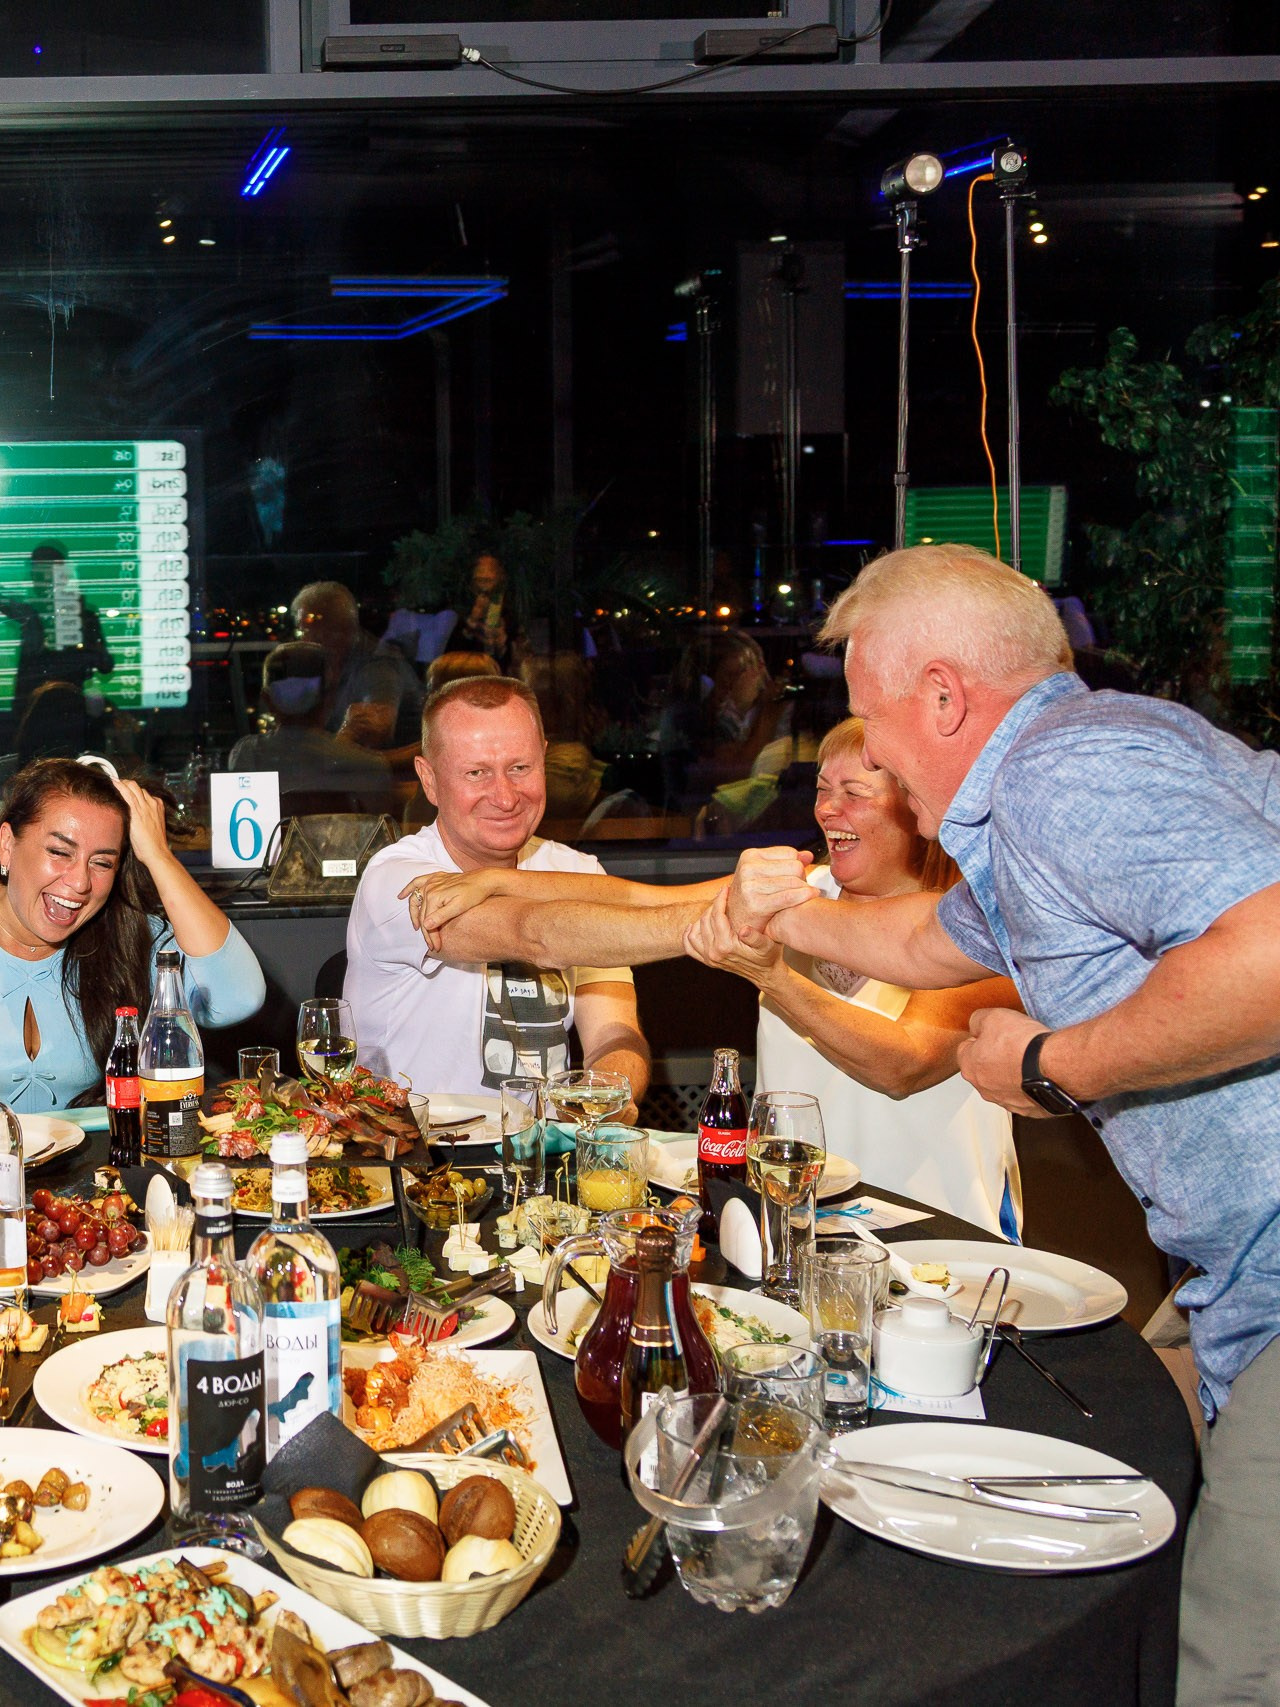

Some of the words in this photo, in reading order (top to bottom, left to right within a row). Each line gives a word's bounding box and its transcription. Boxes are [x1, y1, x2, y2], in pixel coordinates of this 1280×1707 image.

[229, 797, 263, 861] 6
[701, 1137, 747, 1157] Coca-Cola
[266, 1333, 318, 1350] ВОДЫ
[196, 1376, 209, 1394] 4
[212, 1368, 262, 1395] ВОДЫ
